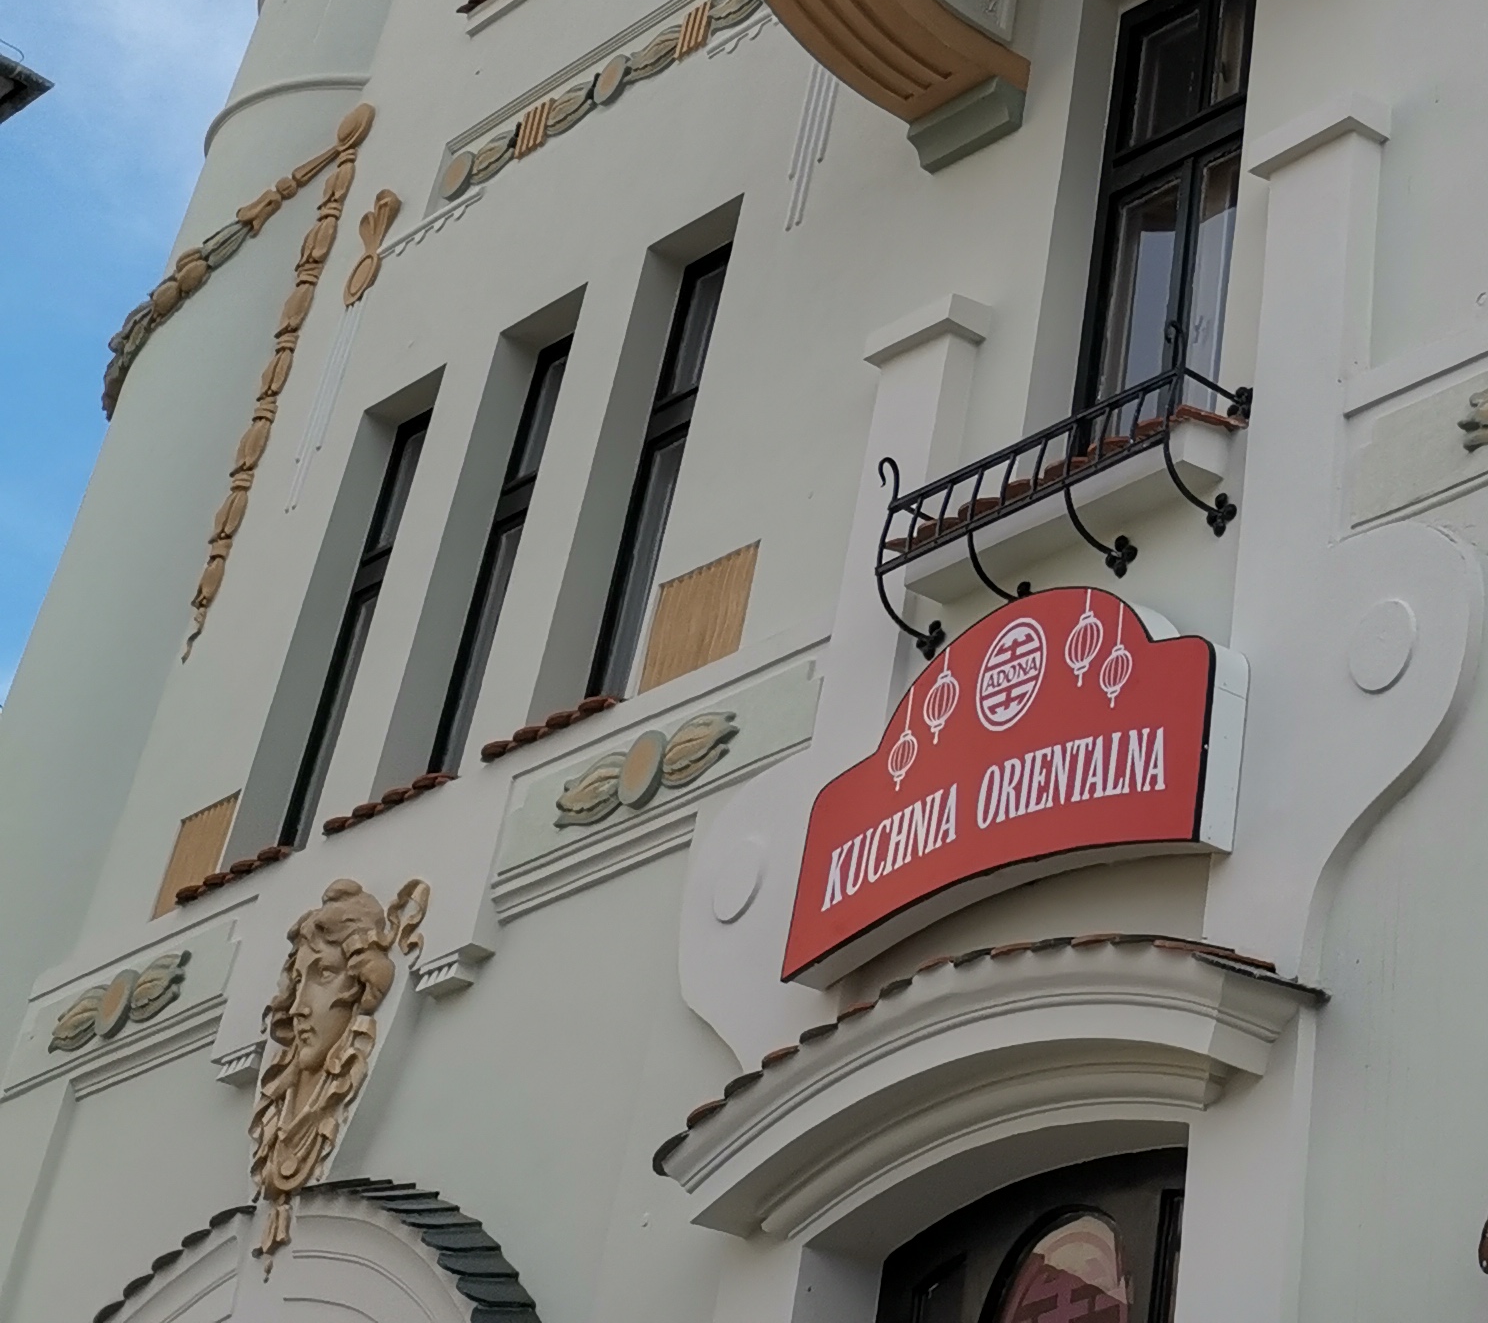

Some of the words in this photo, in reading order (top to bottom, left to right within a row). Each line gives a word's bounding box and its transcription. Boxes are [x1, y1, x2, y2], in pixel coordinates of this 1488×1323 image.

[984, 656, 1039, 690] ADONA
[821, 783, 957, 913] KUCHNIA
[977, 726, 1166, 830] ORIENTALNA
